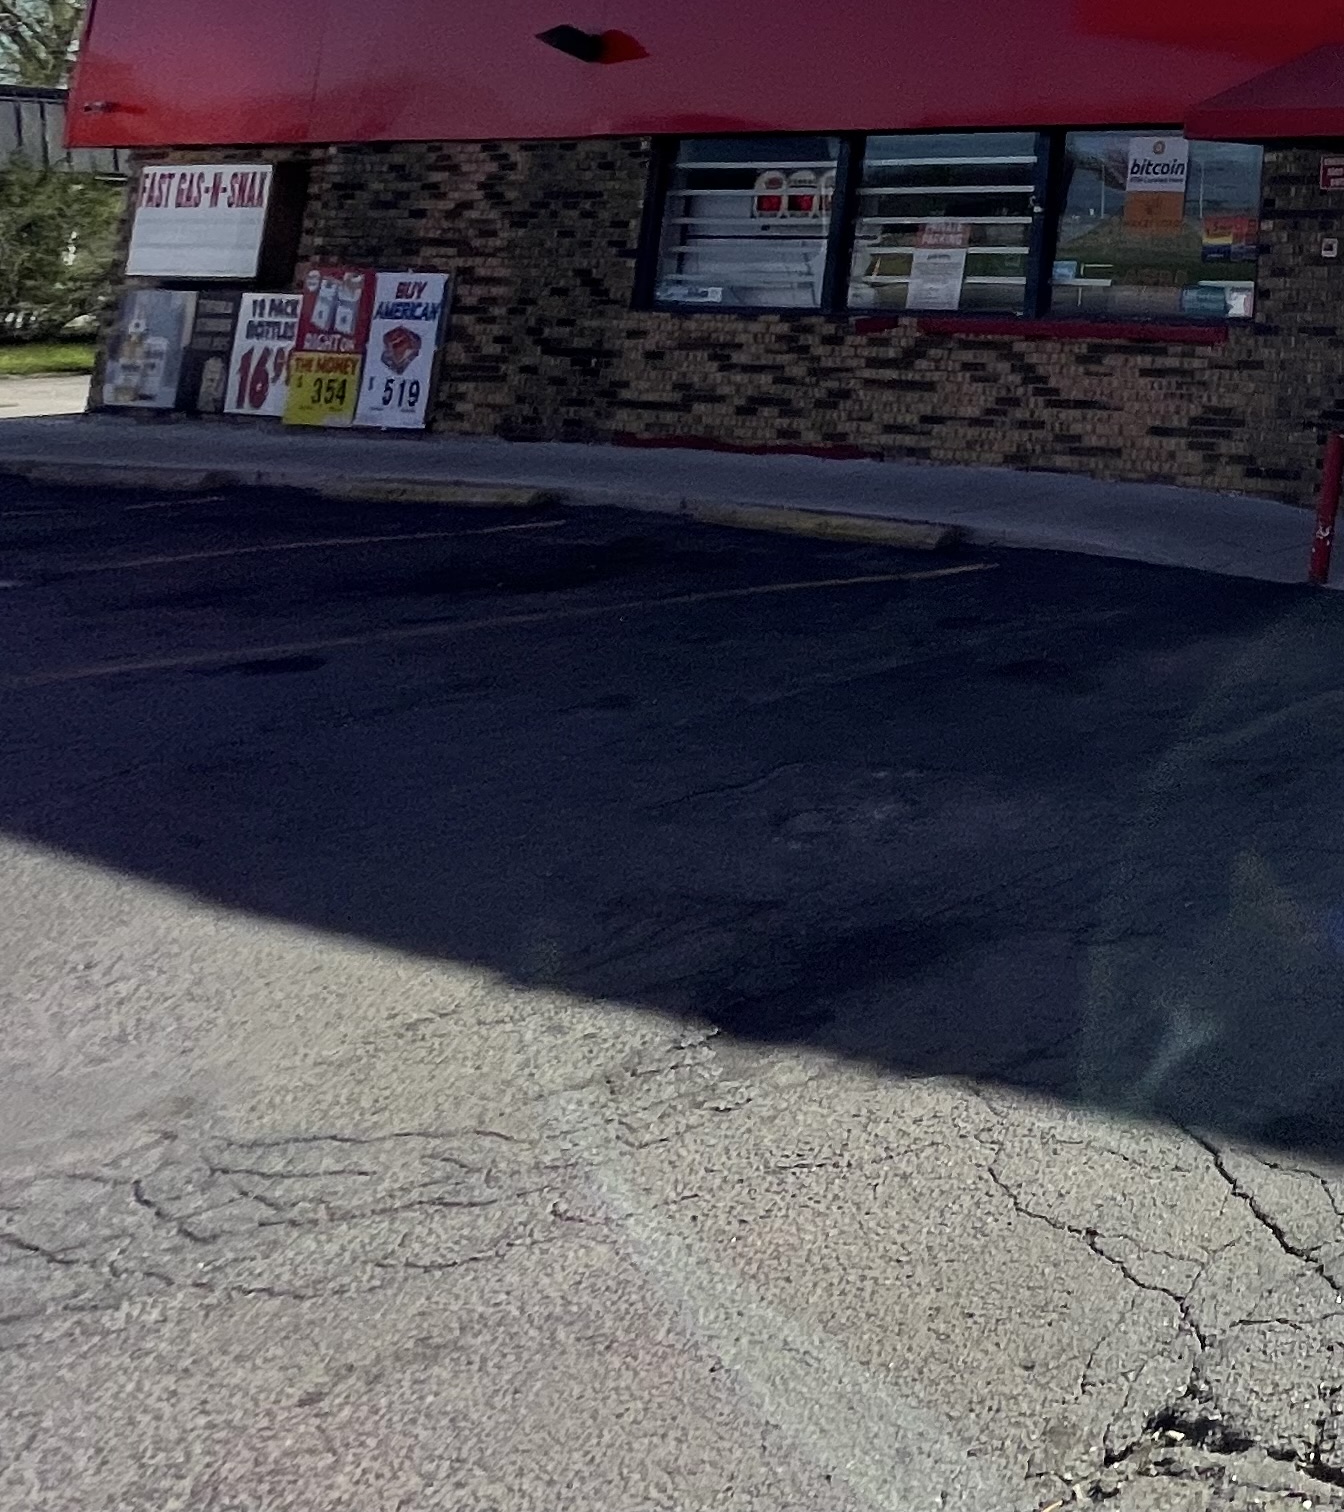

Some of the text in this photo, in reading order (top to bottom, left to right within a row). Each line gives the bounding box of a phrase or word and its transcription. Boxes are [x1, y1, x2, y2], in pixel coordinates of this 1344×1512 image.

[1130, 158, 1185, 175] bitcoin
[139, 172, 175, 208] FAST
[394, 281, 427, 299] BUY
[374, 301, 440, 321] AMERICAN
[311, 378, 346, 406] 354
[382, 378, 420, 407] 519
